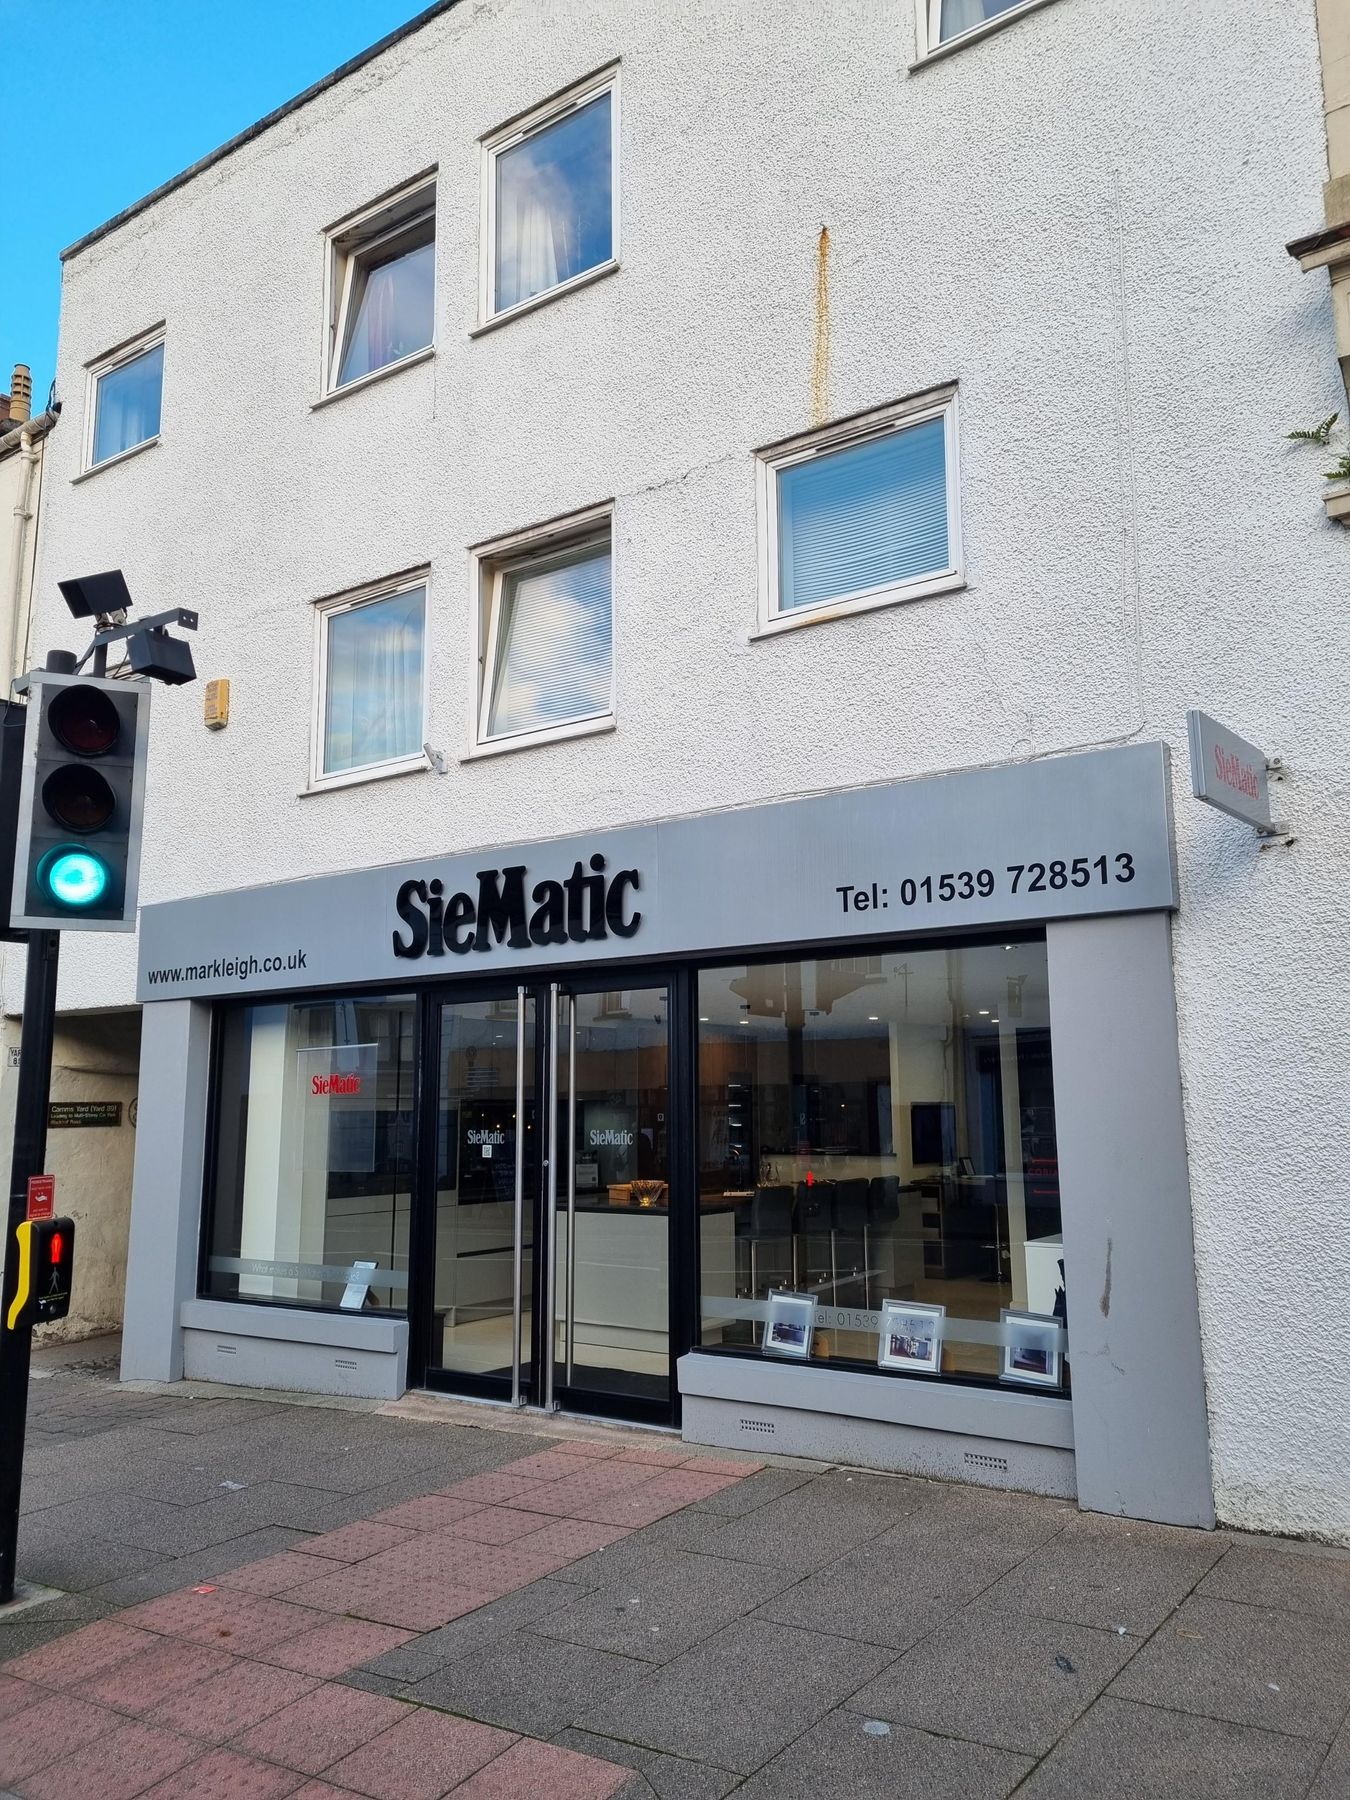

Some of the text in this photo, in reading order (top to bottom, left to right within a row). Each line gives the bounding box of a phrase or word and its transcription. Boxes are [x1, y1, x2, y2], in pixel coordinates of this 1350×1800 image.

[1214, 743, 1260, 801] SieMatic
[836, 852, 1136, 912] Tel: 01539 728513
[392, 853, 642, 959] SieMatic
[148, 949, 307, 985] www.markleigh.co.uk
[311, 1073, 361, 1095] SieMatic
[467, 1129, 505, 1145] SieMatic
[590, 1129, 633, 1145] SieMatic
[837, 1312, 879, 1329] 01539
